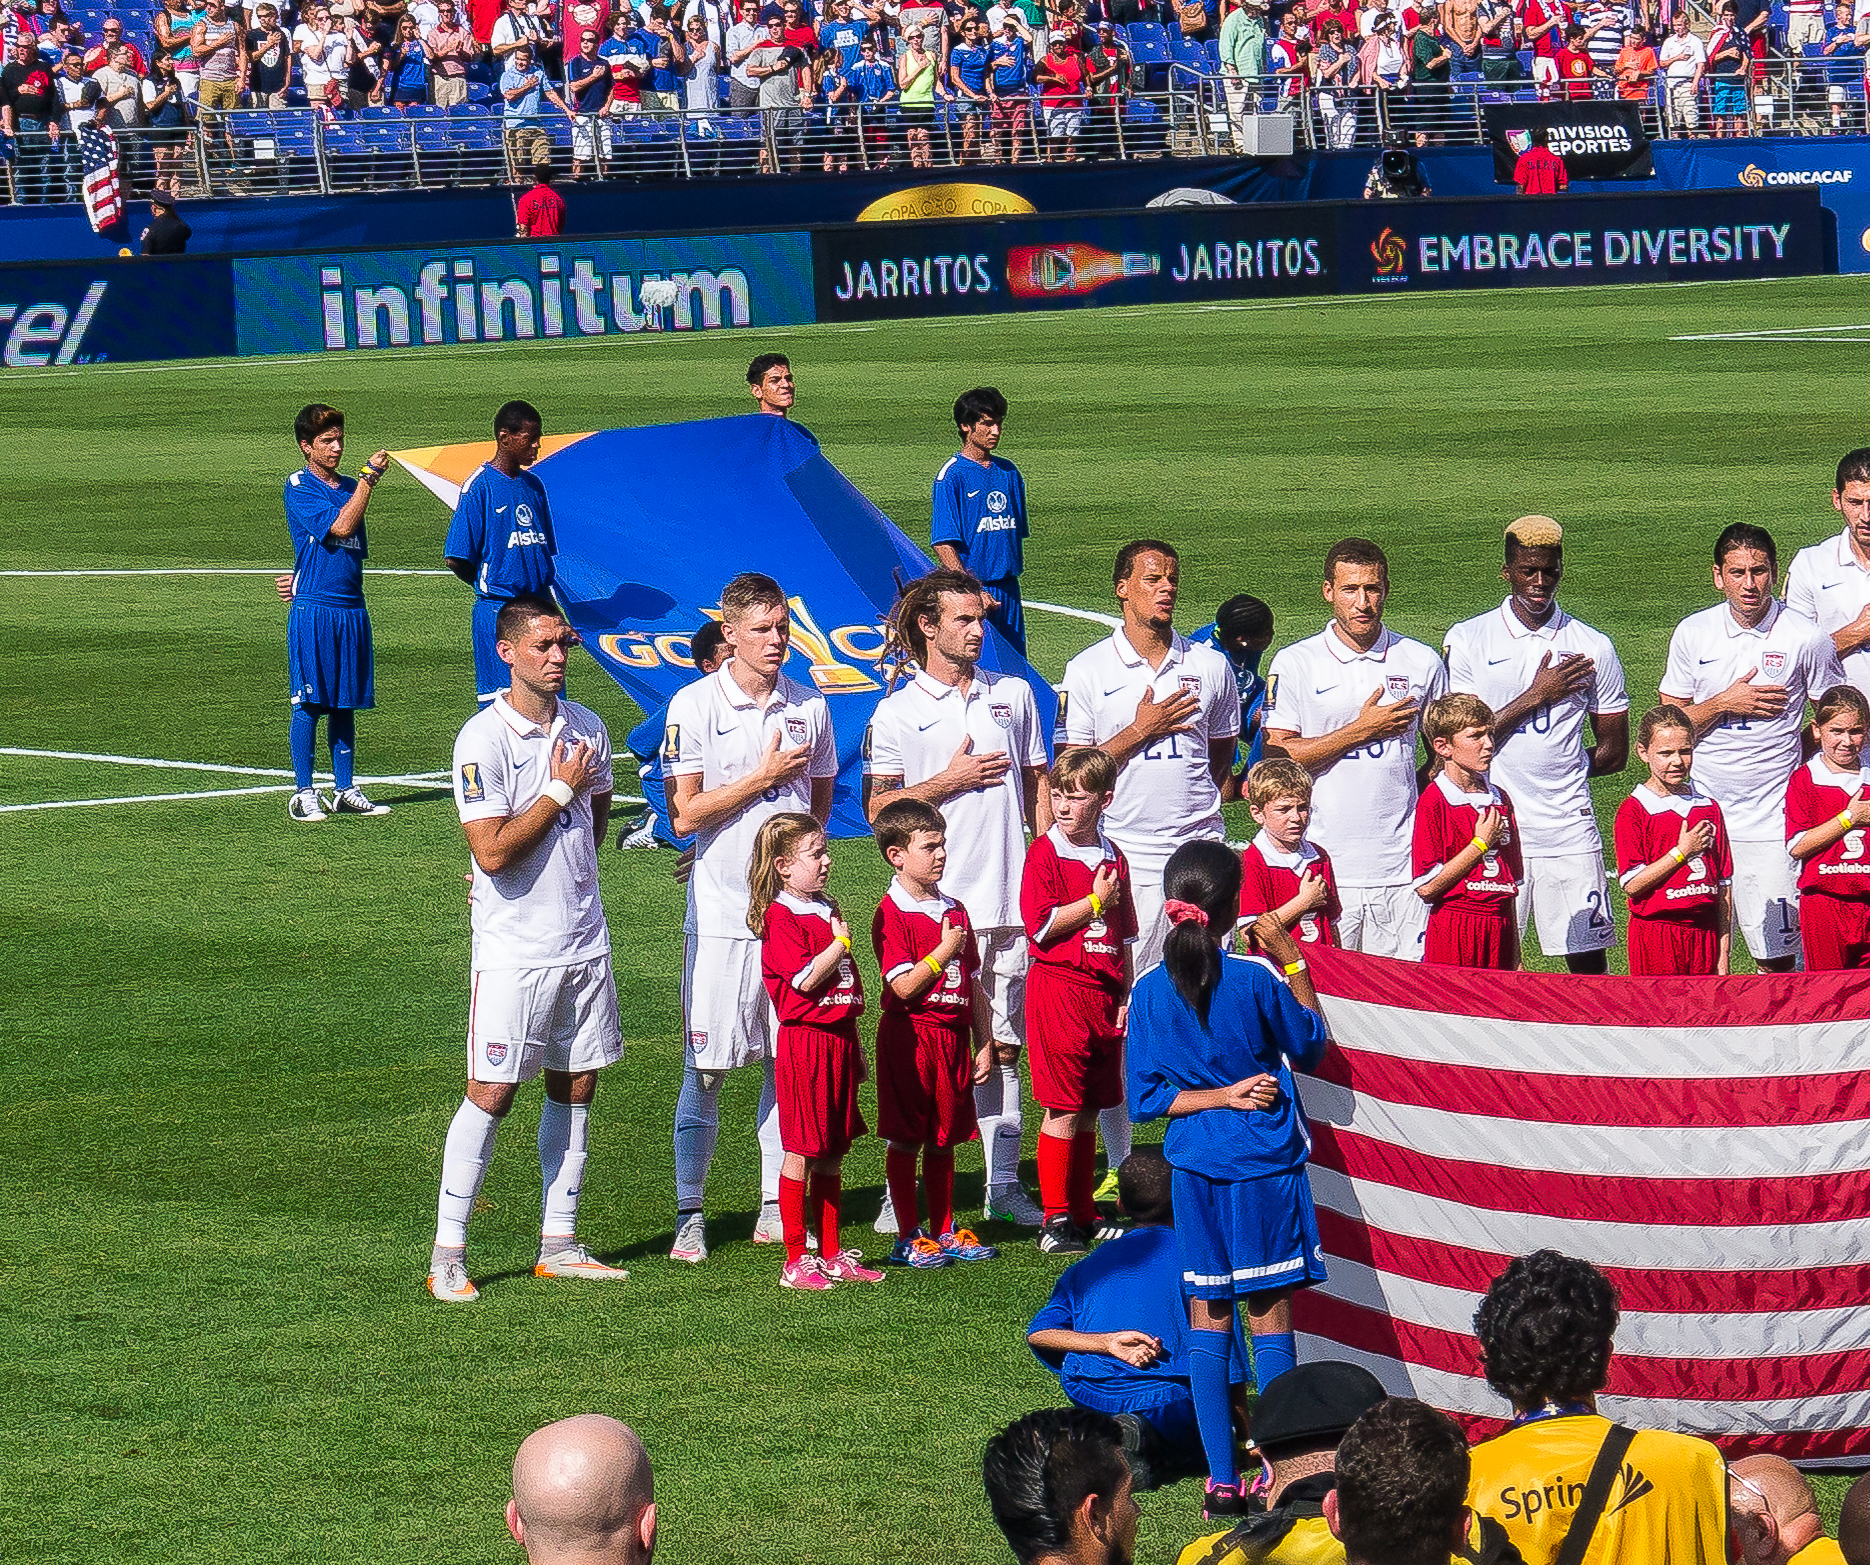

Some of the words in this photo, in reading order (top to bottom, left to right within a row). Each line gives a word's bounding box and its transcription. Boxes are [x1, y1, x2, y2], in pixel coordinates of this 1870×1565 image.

[1767, 170, 1852, 185] CONCACAF
[1172, 238, 1320, 281] JARRITOS
[1420, 231, 1593, 272] EMBRACE
[1605, 223, 1790, 266] DIVERSITY
[836, 254, 991, 299] JARRITOS
[322, 255, 750, 349] infinitum
